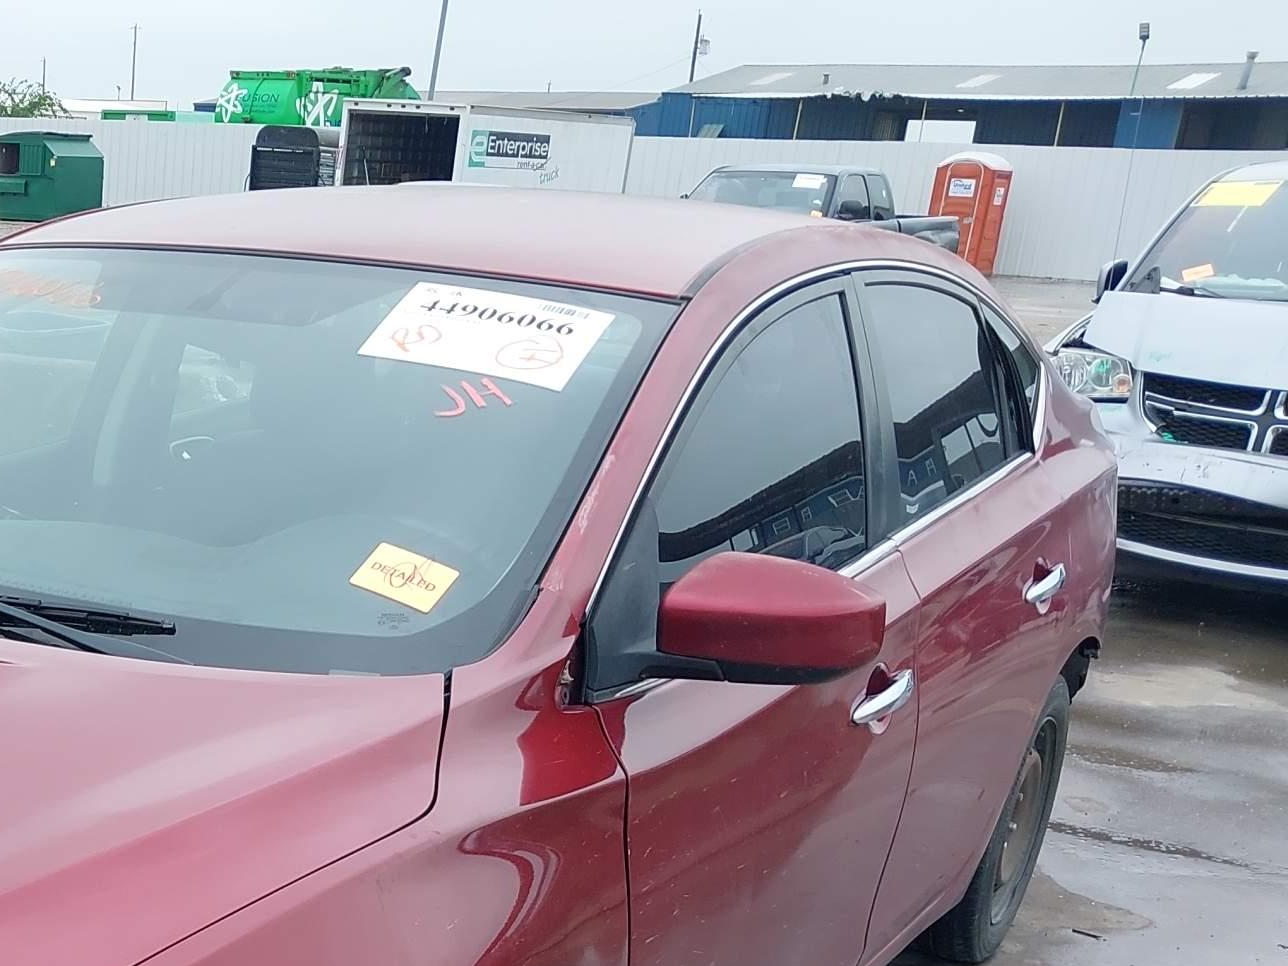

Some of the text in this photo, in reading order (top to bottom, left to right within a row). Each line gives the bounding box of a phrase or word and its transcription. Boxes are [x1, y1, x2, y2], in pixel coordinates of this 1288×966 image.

[487, 135, 549, 158] Enterprise
[420, 299, 574, 335] 44906066
[370, 561, 436, 592] DETAILED
